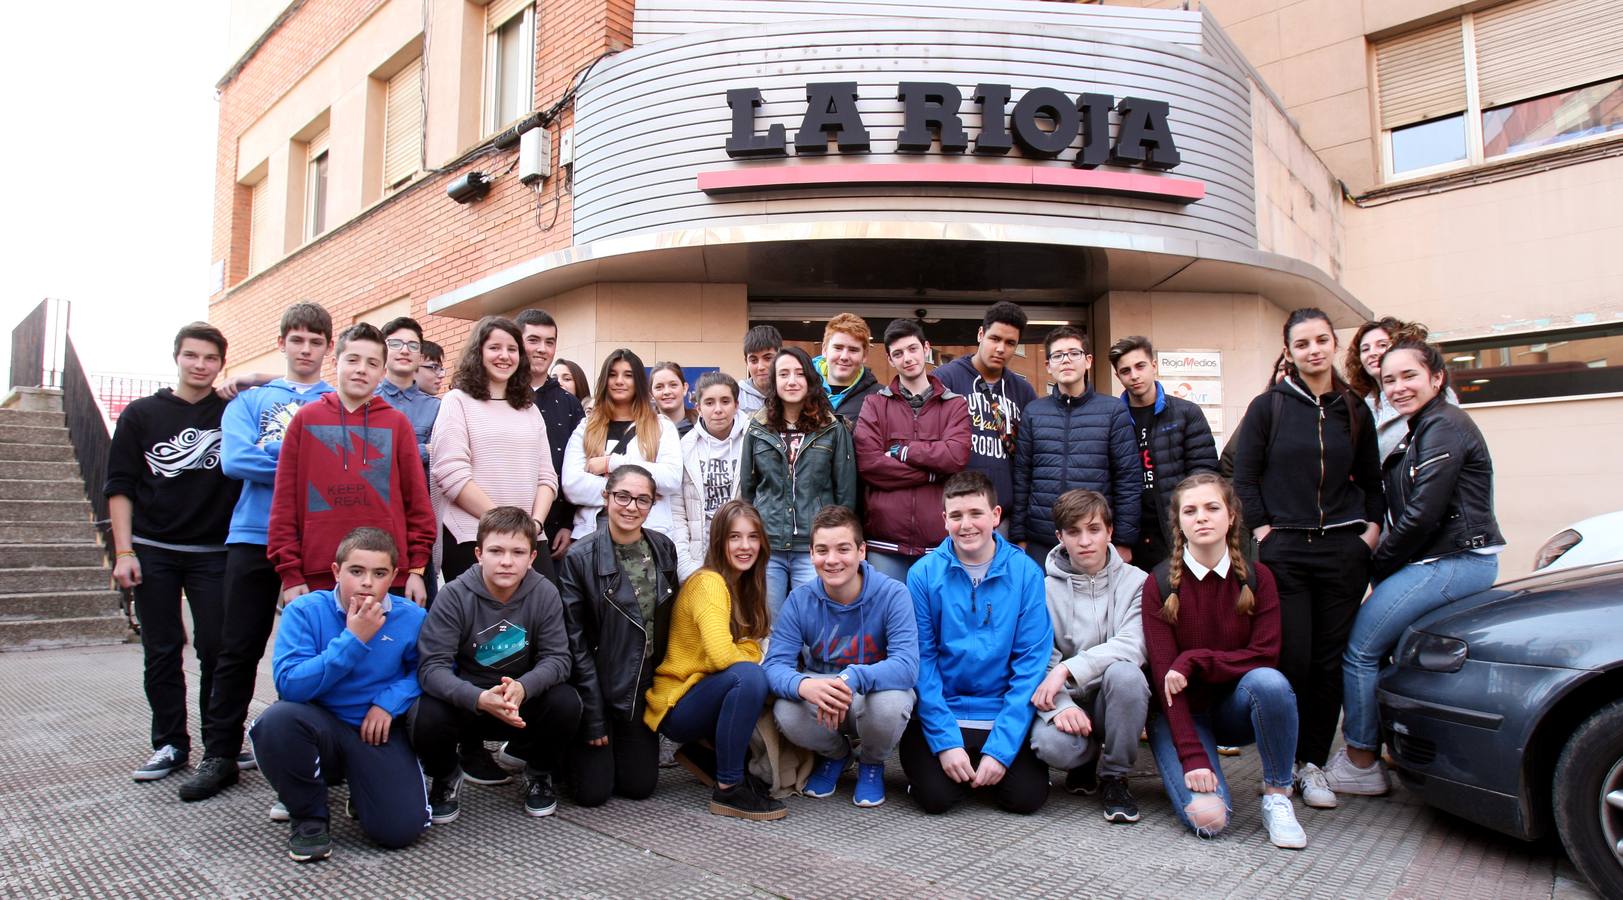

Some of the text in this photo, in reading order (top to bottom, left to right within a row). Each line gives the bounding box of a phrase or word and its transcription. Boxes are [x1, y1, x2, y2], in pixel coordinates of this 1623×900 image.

[725, 81, 1181, 171] LA RIOJA
[1161, 357, 1217, 369] RiojaMedios
[327, 484, 366, 496] KEEP
[707, 484, 731, 499] CITY
[334, 493, 372, 507] REAL
